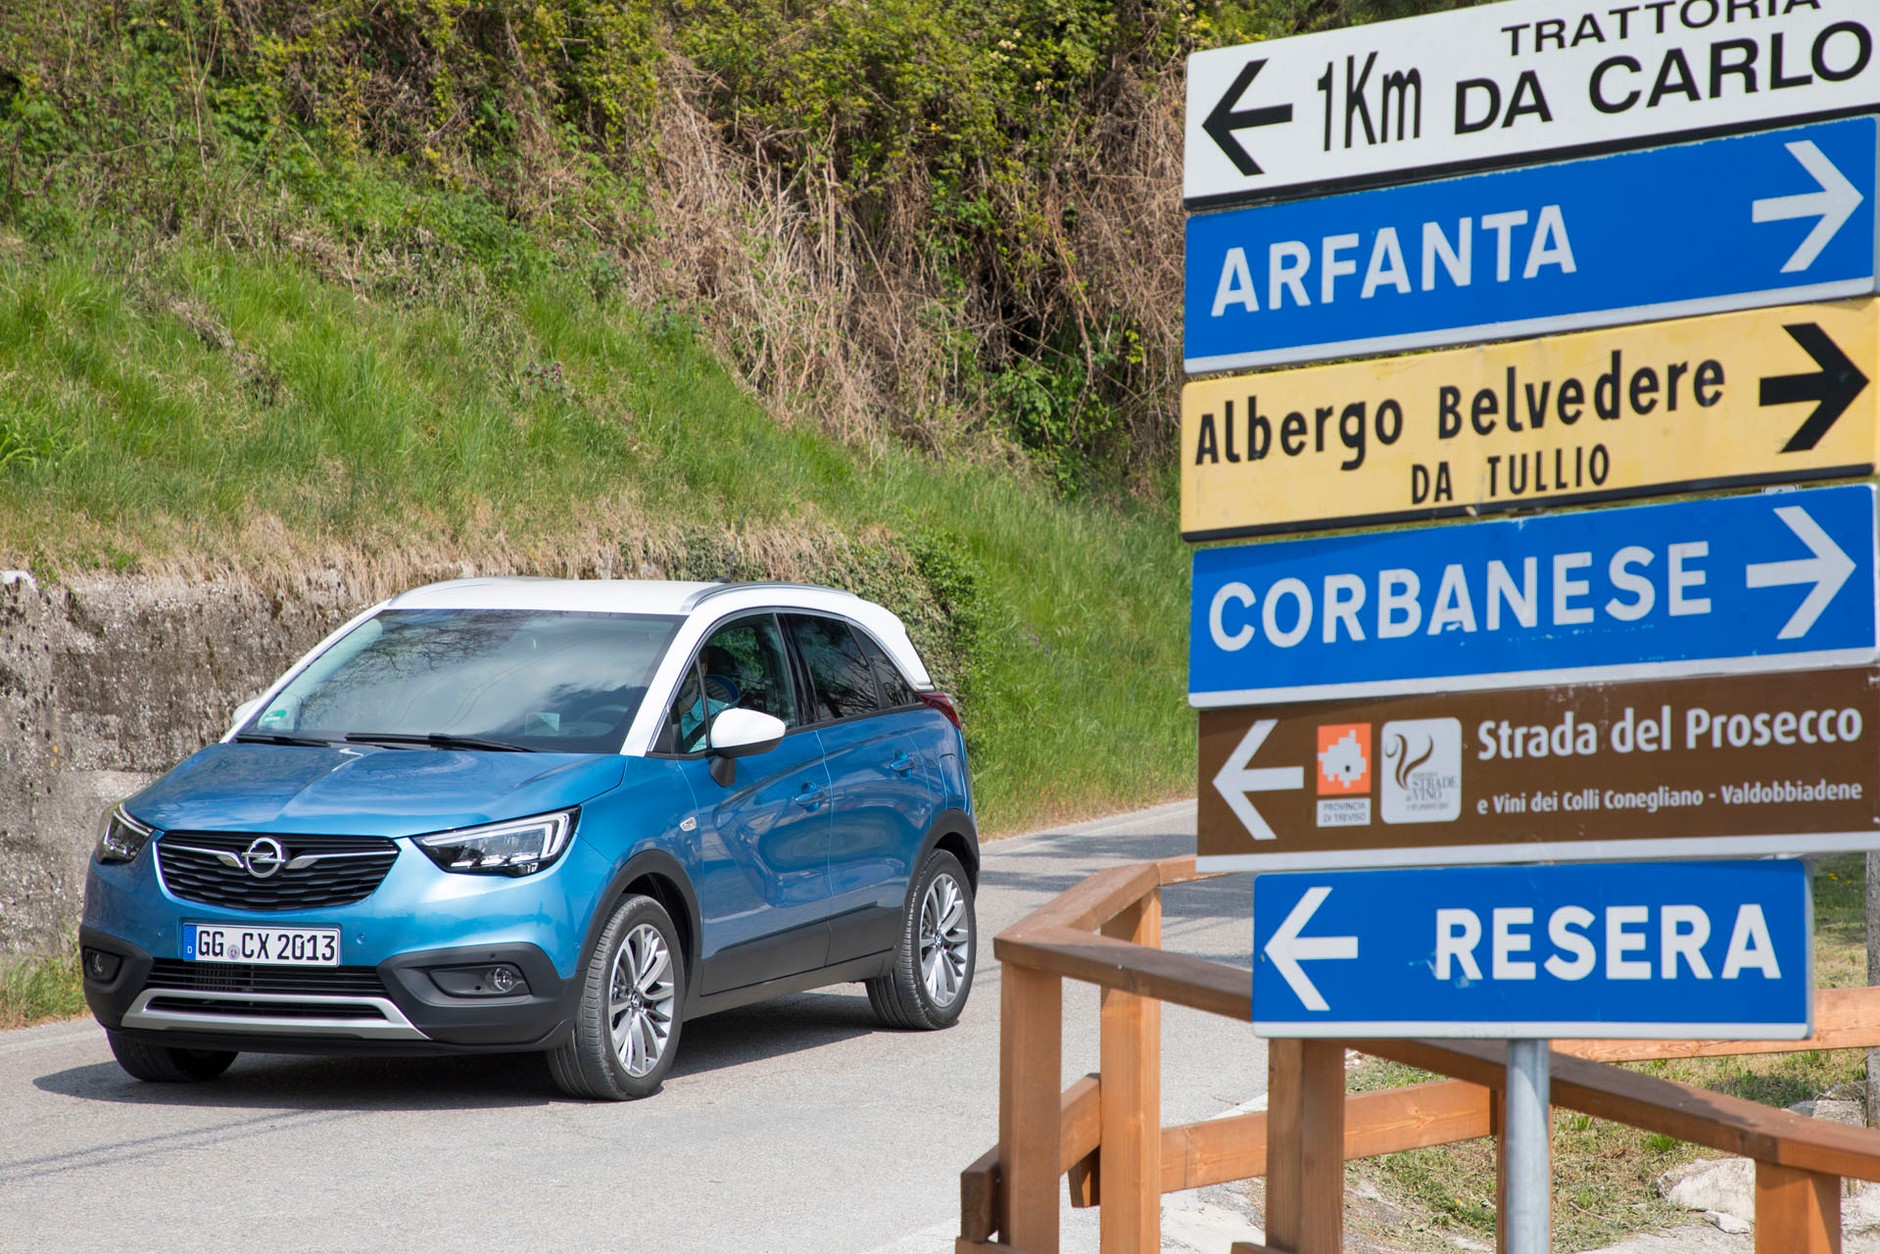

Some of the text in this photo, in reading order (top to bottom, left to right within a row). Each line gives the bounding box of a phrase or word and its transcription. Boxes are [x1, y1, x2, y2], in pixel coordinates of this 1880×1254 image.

[1317, 51, 1422, 151] 1Km
[1454, 20, 1872, 135] DA CARLO
[1211, 204, 1577, 318] ARFANTA
[1196, 350, 1725, 471] Albergo Belvedere
[1411, 444, 1610, 504] DA TULLIO
[1209, 541, 1712, 652] CORBANESE
[1477, 704, 1863, 761] Strada del Prosecco
[1477, 799, 1489, 815] e
[1492, 793, 1527, 814] Vini
[1530, 791, 1558, 813] dei
[1562, 788, 1600, 811] Colli
[1603, 785, 1704, 813] Conegliano
[1721, 778, 1863, 804] Valdobbiadene
[198, 930, 335, 961] GG CX 2013
[1435, 904, 1782, 981] RESERA
